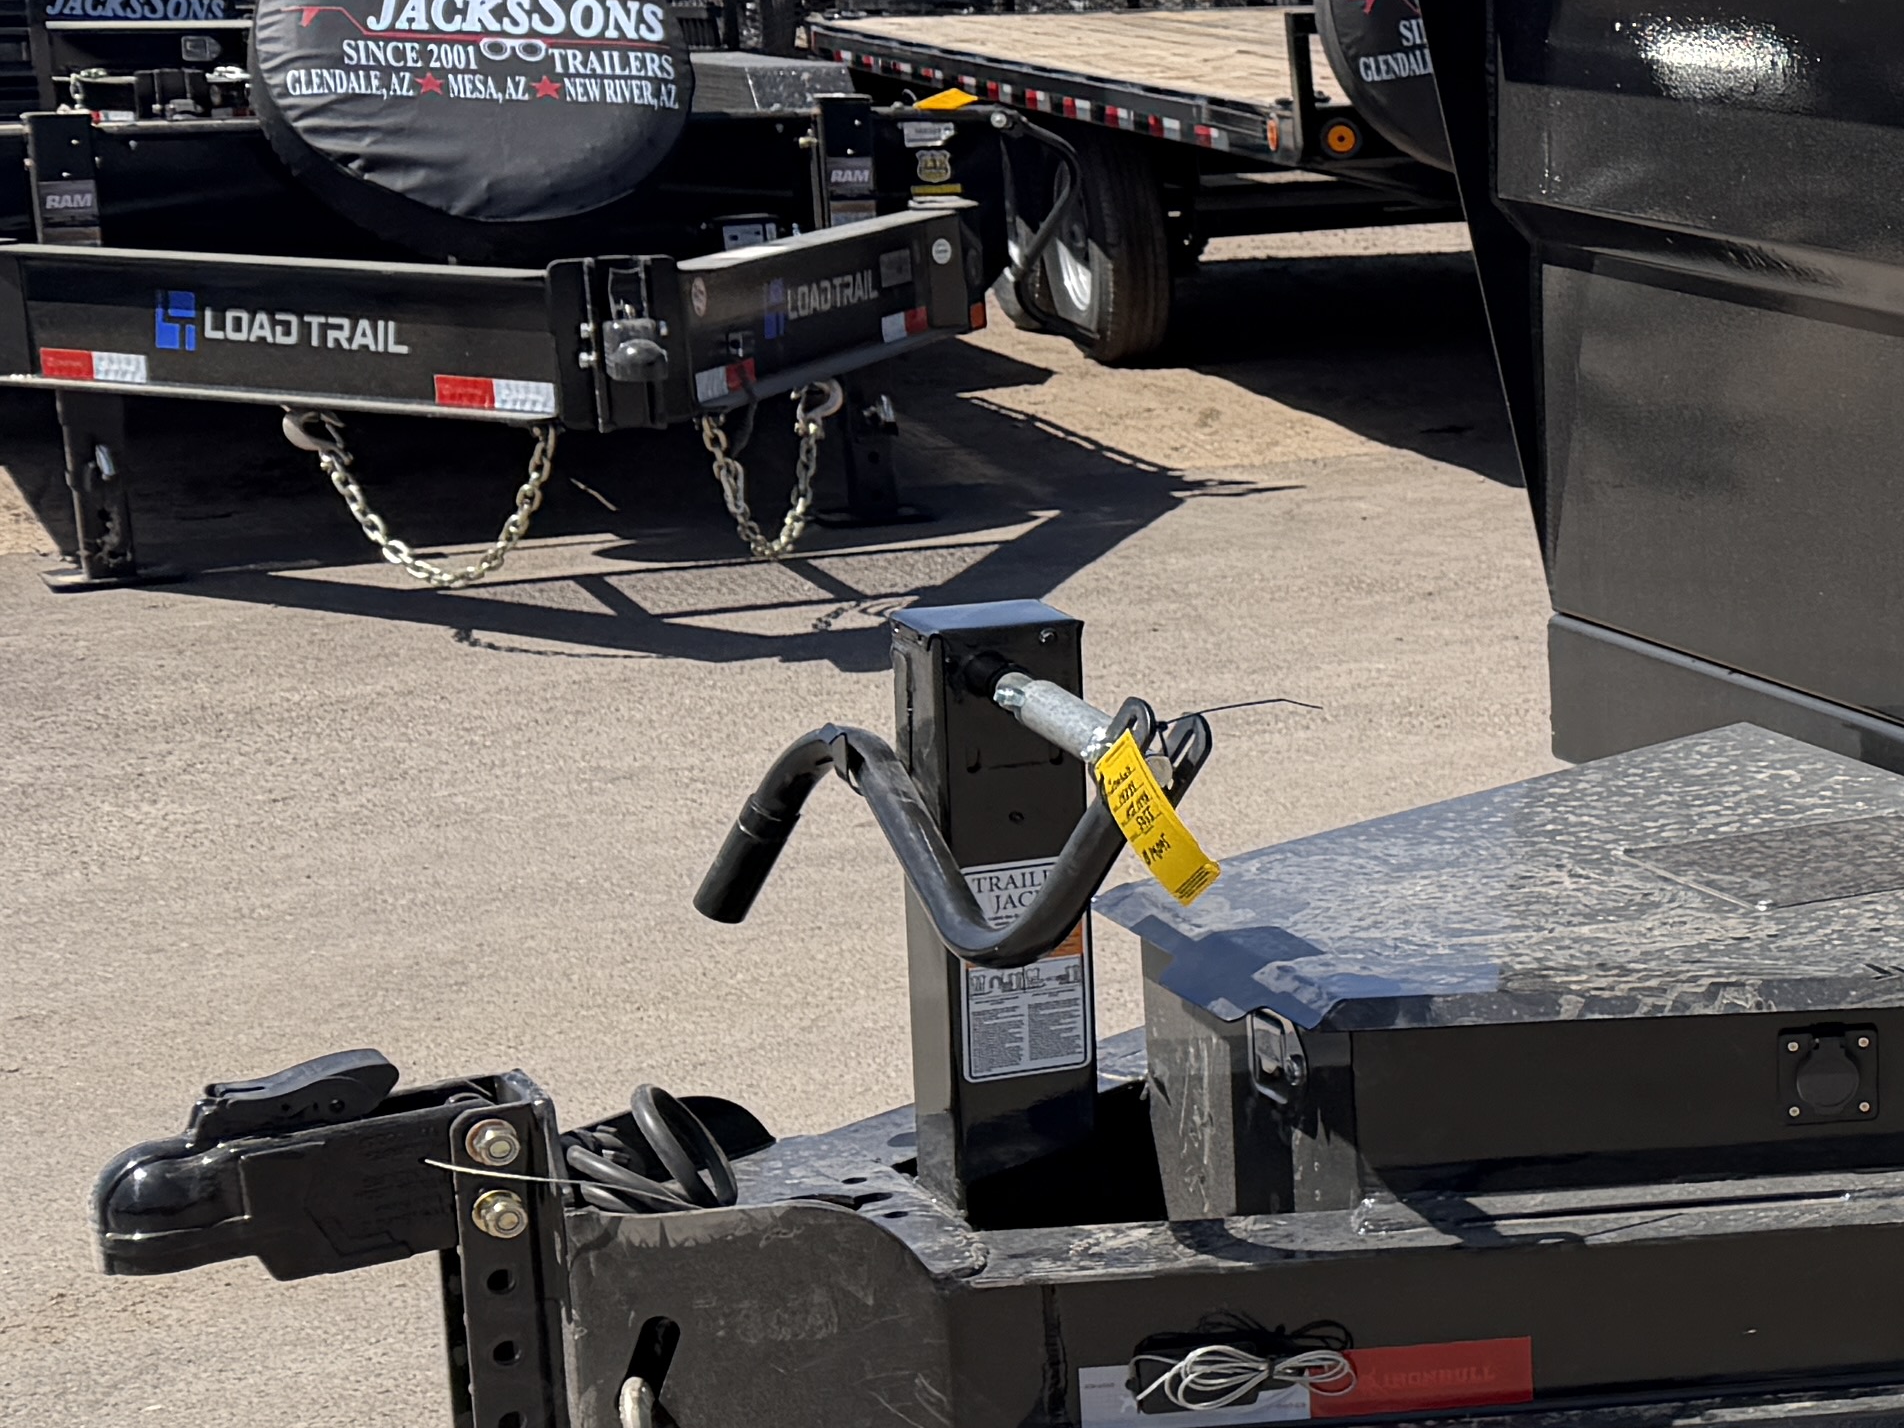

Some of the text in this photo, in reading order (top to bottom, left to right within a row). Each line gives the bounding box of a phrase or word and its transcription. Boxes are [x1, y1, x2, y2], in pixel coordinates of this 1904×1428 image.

[342, 39, 676, 80] SINCE 2001 TRAILERS
[286, 70, 679, 110] GLENDALE, AZ MESA, AZ NEW RIVER, AZ
[831, 169, 870, 183] RAM
[46, 193, 92, 209] RAM
[787, 269, 879, 320] LOAD TRAIL
[204, 307, 409, 354] LOAD TRAIL
[994, 889, 1042, 914] JAC
